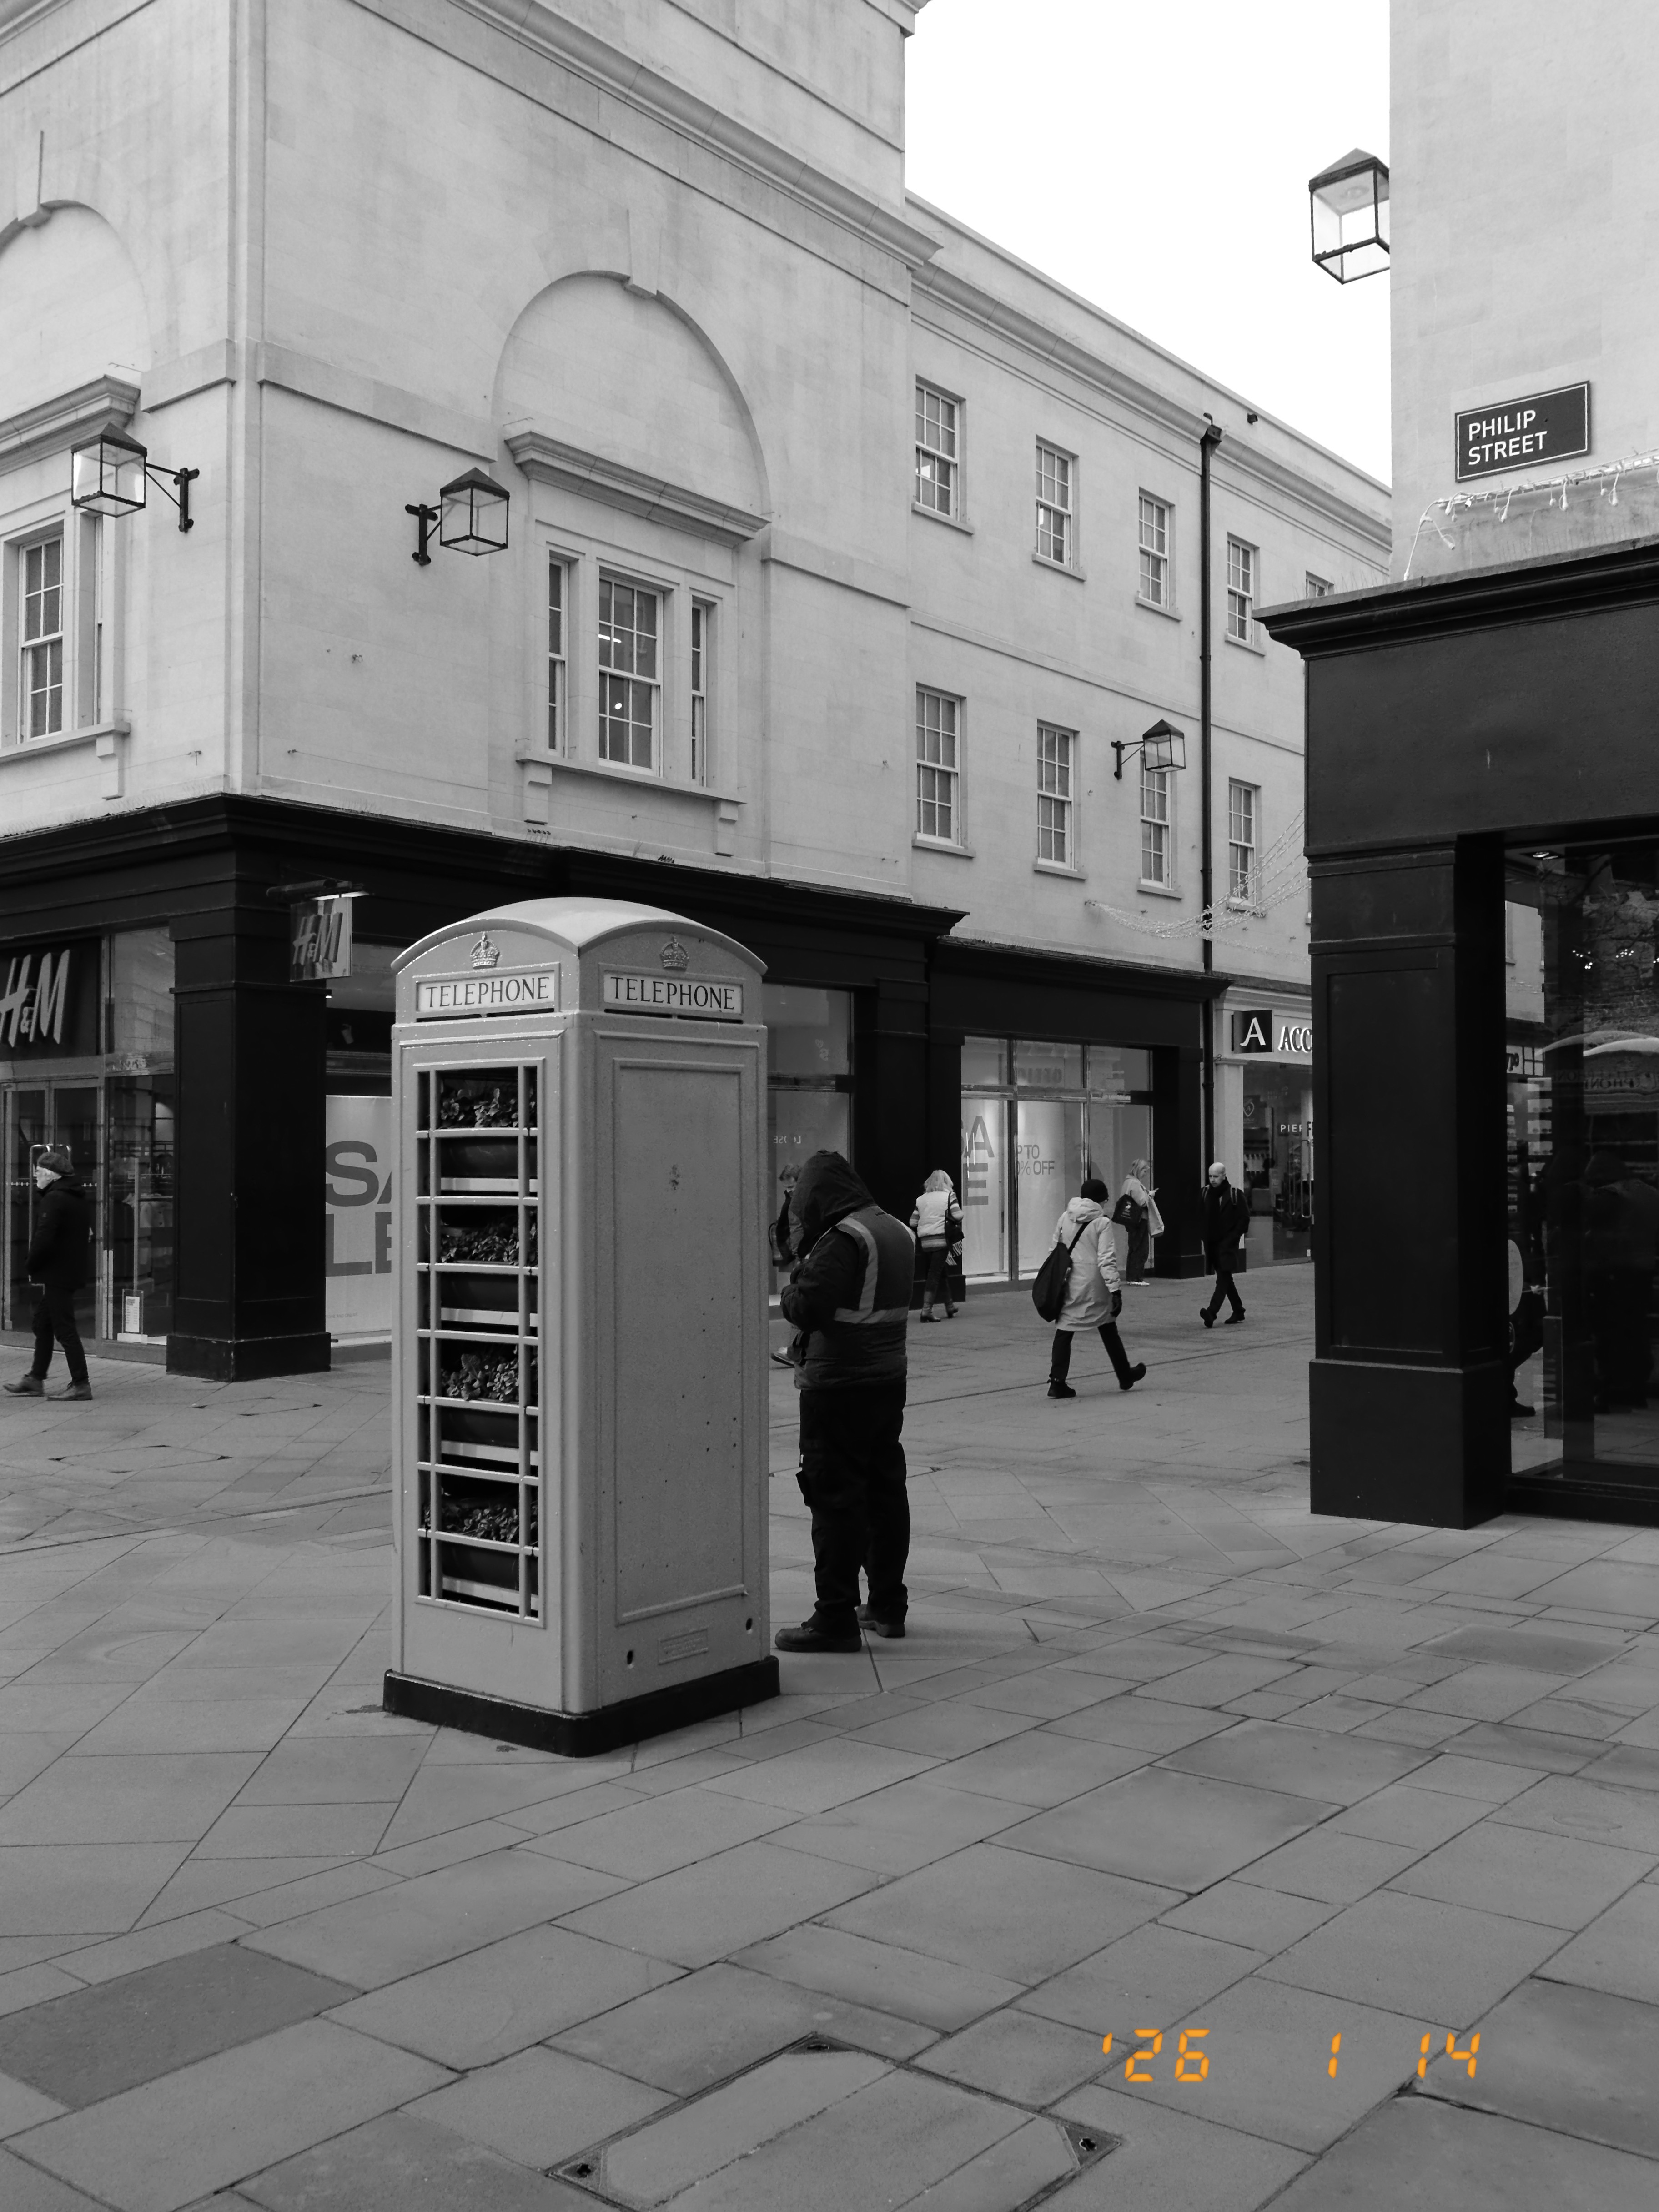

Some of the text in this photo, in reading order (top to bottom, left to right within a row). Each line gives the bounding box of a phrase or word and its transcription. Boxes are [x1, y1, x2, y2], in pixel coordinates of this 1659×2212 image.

[1468, 410, 1536, 441] PHILIP
[1468, 430, 1548, 465] STREET
[293, 912, 343, 965] H&M
[0, 949, 70, 1048] H&M
[426, 976, 549, 1008] TELEPHONE
[610, 976, 734, 1010] TELEPHONE
[1240, 1017, 1266, 1047] A
[961, 1116, 995, 1158] A
[1024, 1144, 1040, 1159] TO
[1033, 1160, 1055, 1175] OFF
